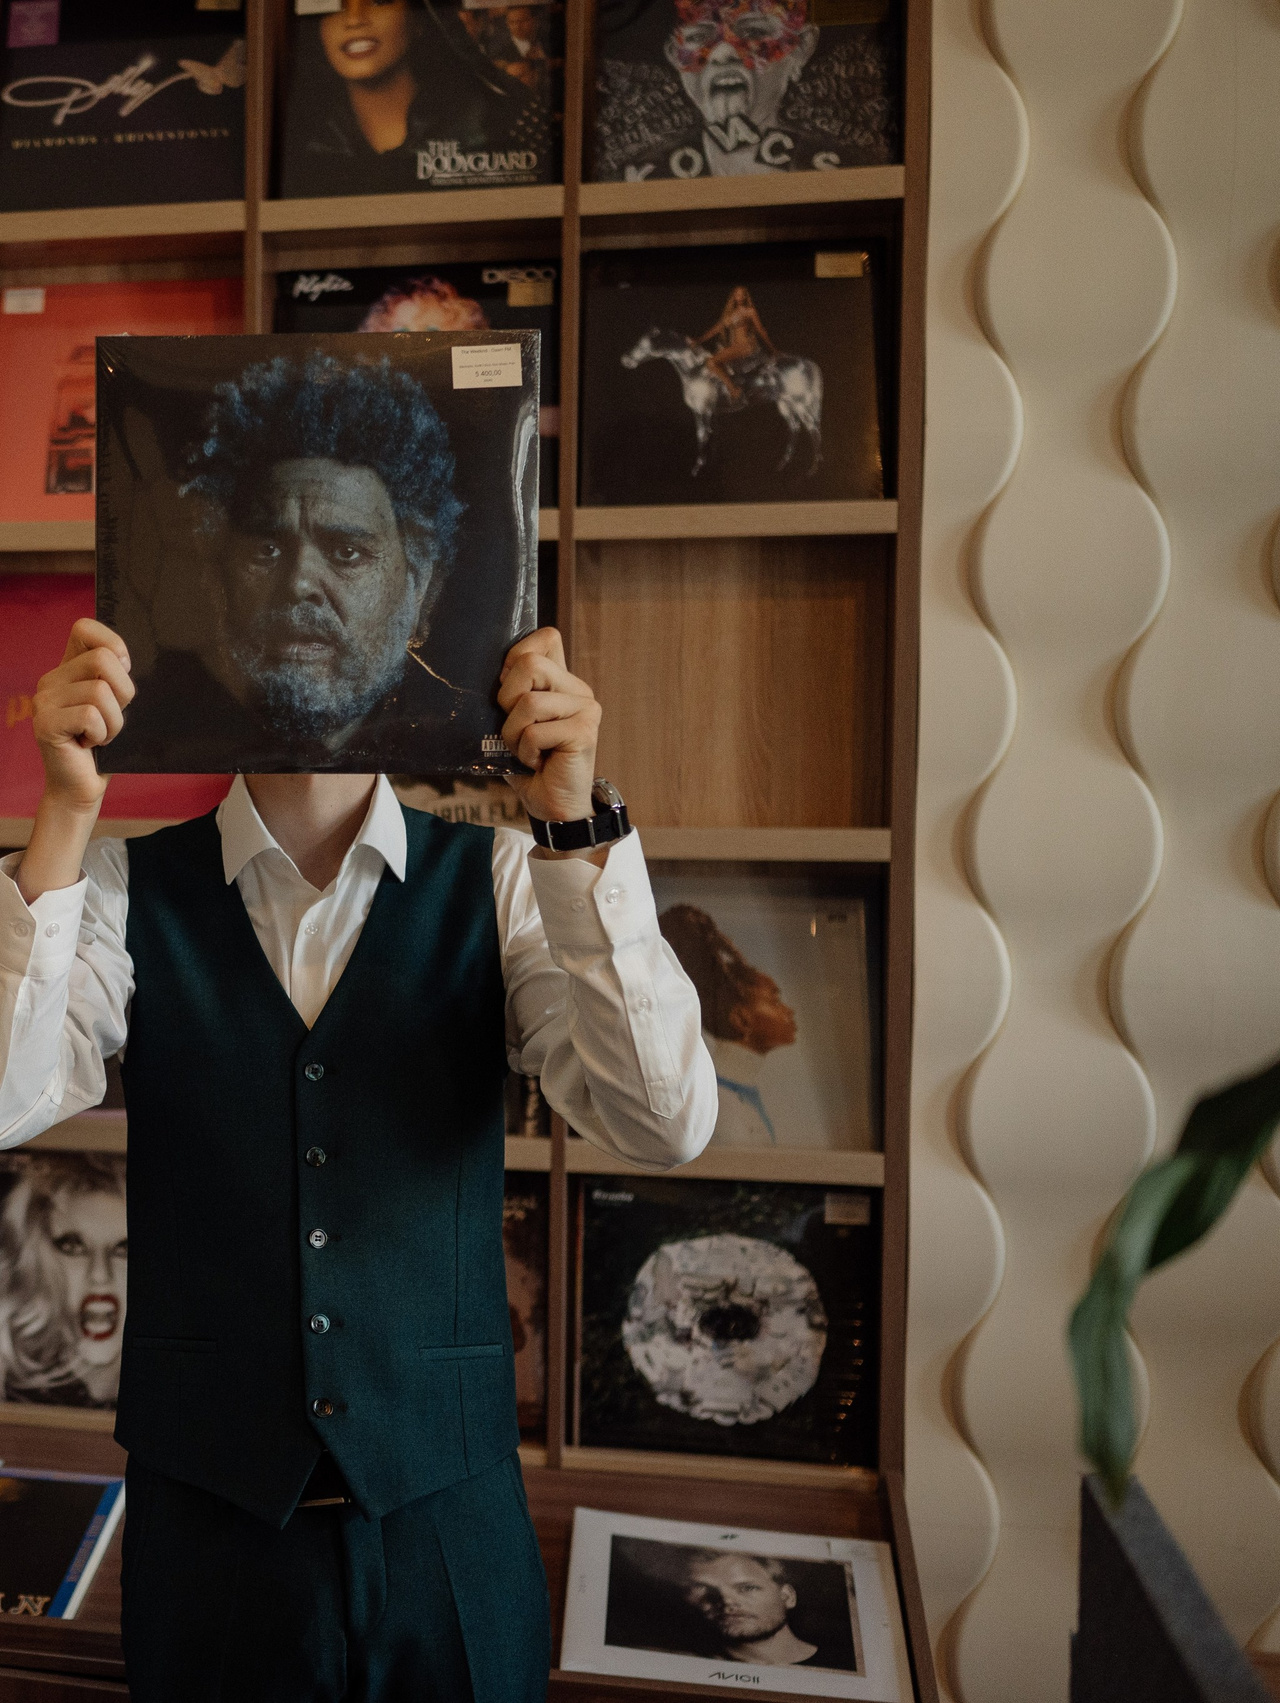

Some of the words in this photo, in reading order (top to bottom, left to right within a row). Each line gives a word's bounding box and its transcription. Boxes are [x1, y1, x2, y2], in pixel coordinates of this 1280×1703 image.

[428, 140, 460, 157] THE
[417, 150, 538, 180] BODYGUARD
[481, 266, 557, 284] DISCO
[483, 740, 508, 751] ADVIS
[488, 800, 525, 823] FLA
[708, 1672, 760, 1685] AVICII
